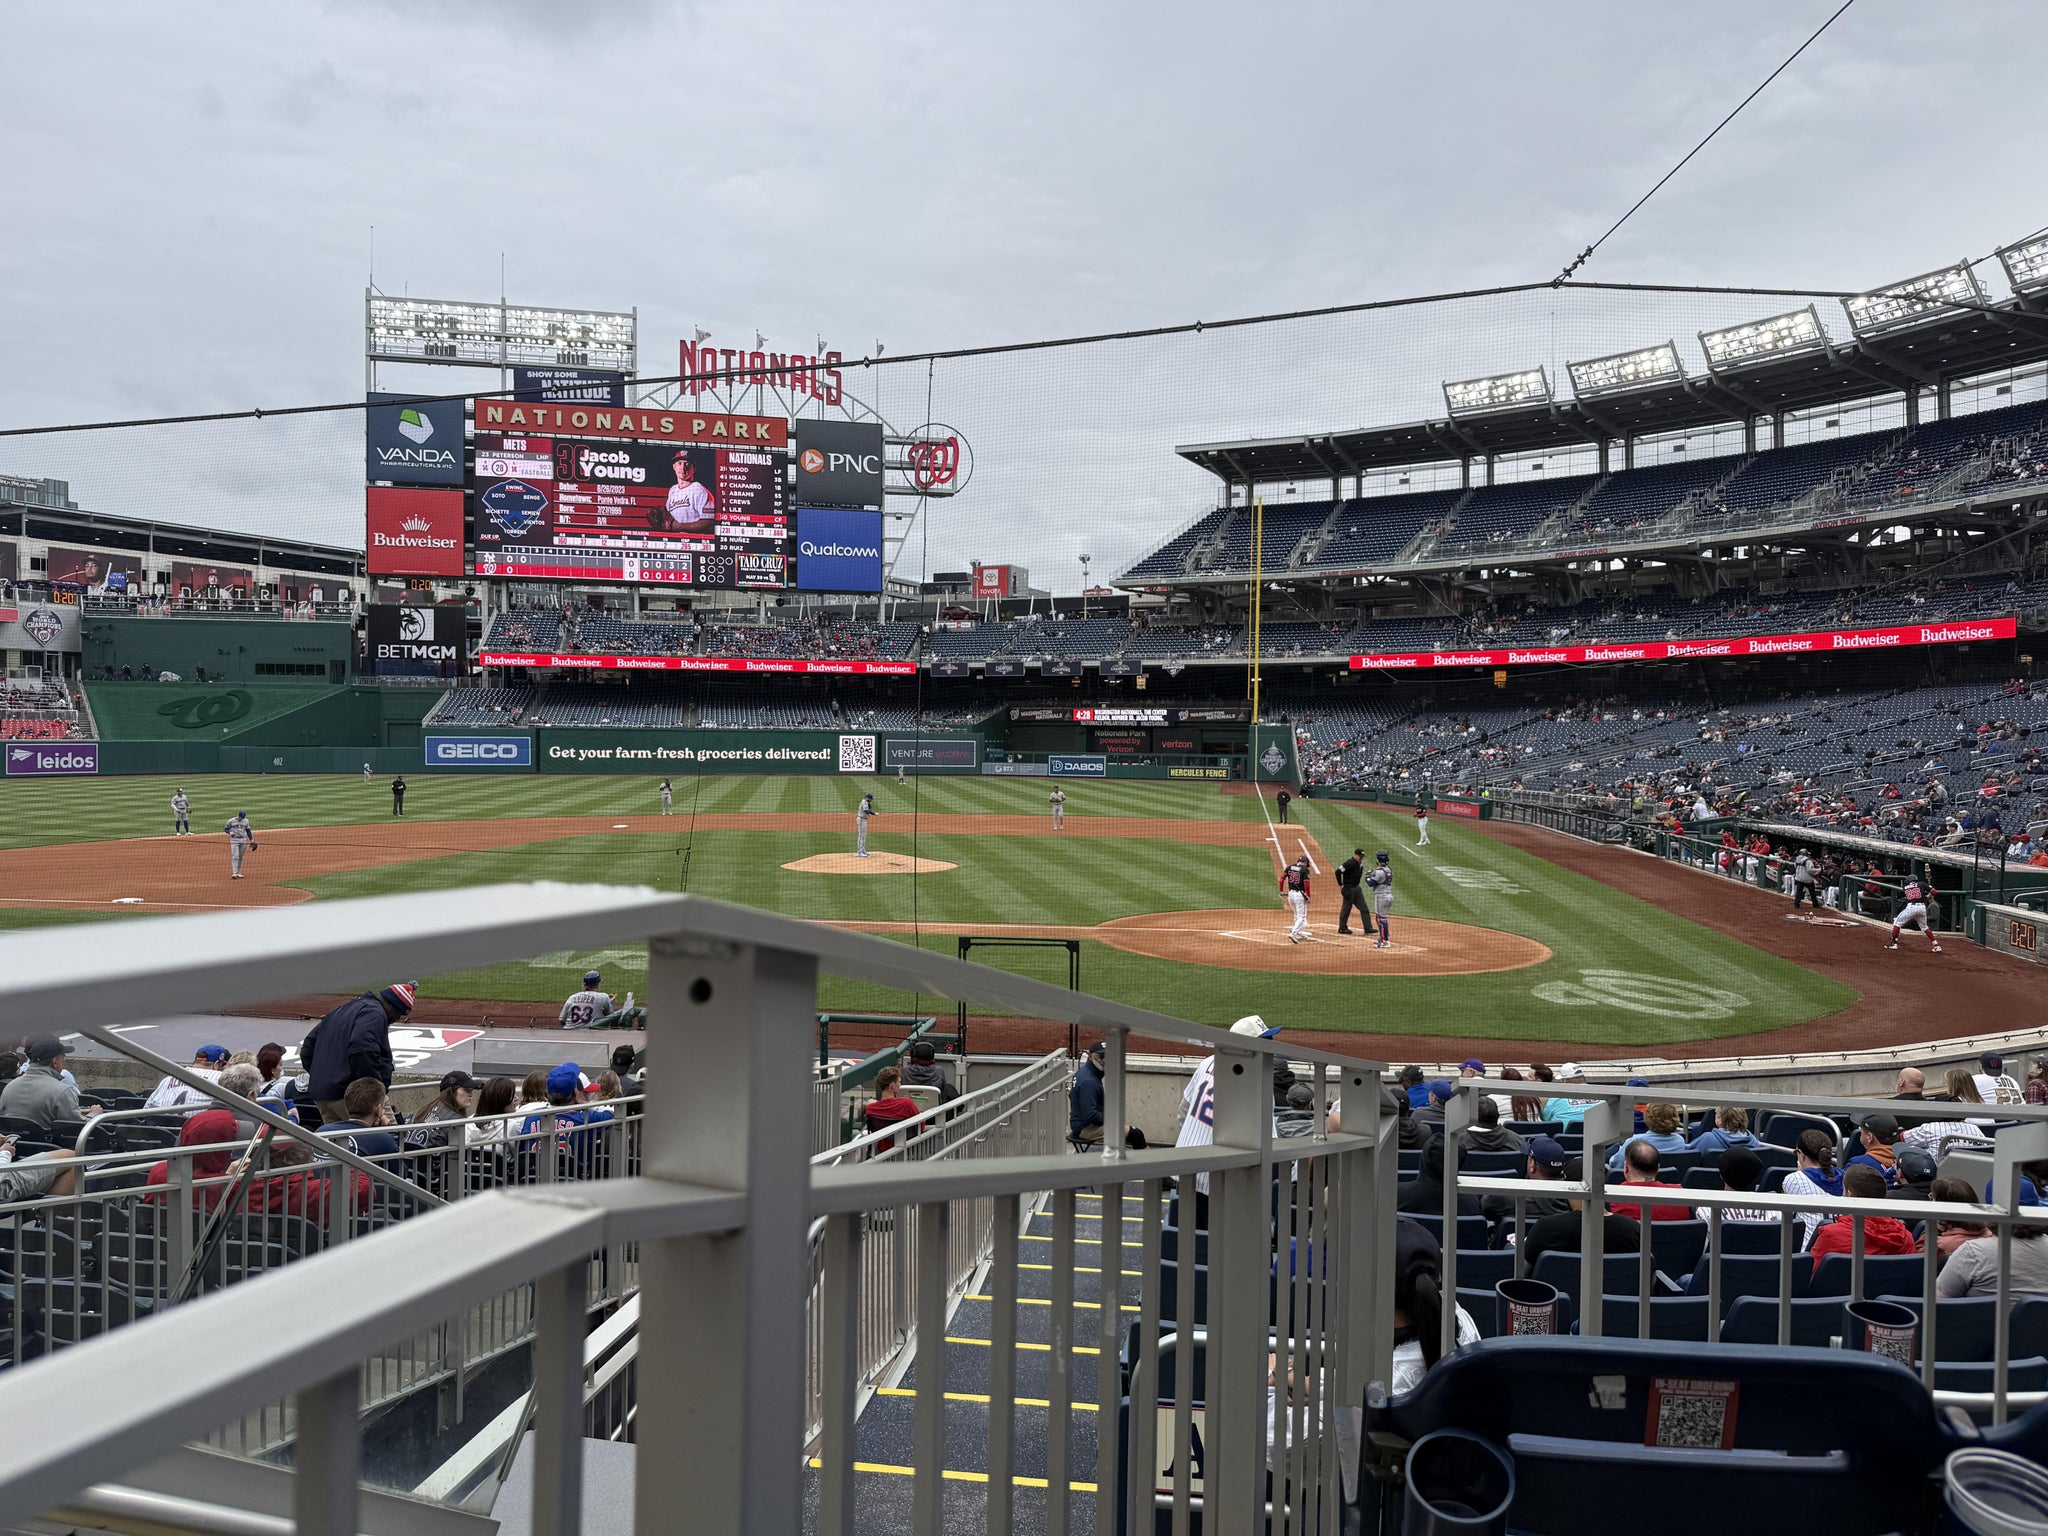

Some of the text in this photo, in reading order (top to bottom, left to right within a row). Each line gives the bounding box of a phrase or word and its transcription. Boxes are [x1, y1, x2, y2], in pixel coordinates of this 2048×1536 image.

[680, 339, 842, 406] NATIONALS
[542, 380, 610, 398] NATITUDE
[487, 406, 771, 440] NATIONALS PARK
[503, 439, 527, 451] METS
[377, 447, 456, 463] VANDA
[579, 449, 630, 464] Jacob
[729, 452, 772, 466] NATIONALS
[827, 453, 880, 474] PNC
[579, 462, 646, 482] Young
[597, 496, 613, 504] Ponte
[631, 497, 636, 505] FL
[373, 532, 457, 548] Budweiser
[800, 541, 878, 559] Qualcomm
[739, 555, 783, 569] TAIO CRUZ
[411, 580, 432, 591] 0:20
[54, 591, 74, 605] 0:20
[26, 622, 61, 630] CHAMPIONS
[1832, 634, 1900, 647] Budweiser
[1920, 626, 1993, 642] Budweiser
[378, 645, 456, 659] BETMGM
[1667, 644, 1730, 657] Budweiser
[1749, 639, 1812, 652] Budweiser
[484, 656, 536, 665] Budweiser
[1434, 655, 1491, 665] Budweiser
[1508, 652, 1567, 662] Budweiser
[1585, 649, 1644, 660] Budweiser
[551, 657, 602, 666] Budweiser
[617, 659, 666, 668] Budweiser
[681, 660, 728, 669] Budweiser
[746, 662, 793, 670] Budweiser
[807, 663, 852, 672] Budweiser
[866, 664, 911, 672] Budweiser
[1362, 658, 1416, 668] Budweiser
[1076, 710, 1090, 720] 4:28
[1161, 740, 1193, 748] verizon
[438, 744, 518, 758] GEICO
[550, 746, 830, 762] Get your farm-fresh groceries delivered!
[892, 750, 933, 758] VENTURE
[37, 752, 94, 768] leidos
[1065, 762, 1103, 770] DABOS
[1170, 769, 1204, 777] HERCULES
[2011, 921, 2036, 951] 0:20
[570, 1005, 594, 1024] 63
[1994, 1078, 2015, 1088] SOTO
[1995, 1088, 2021, 1104] 22
[1655, 1378, 1735, 1391] IN-SEAT ORDERING
